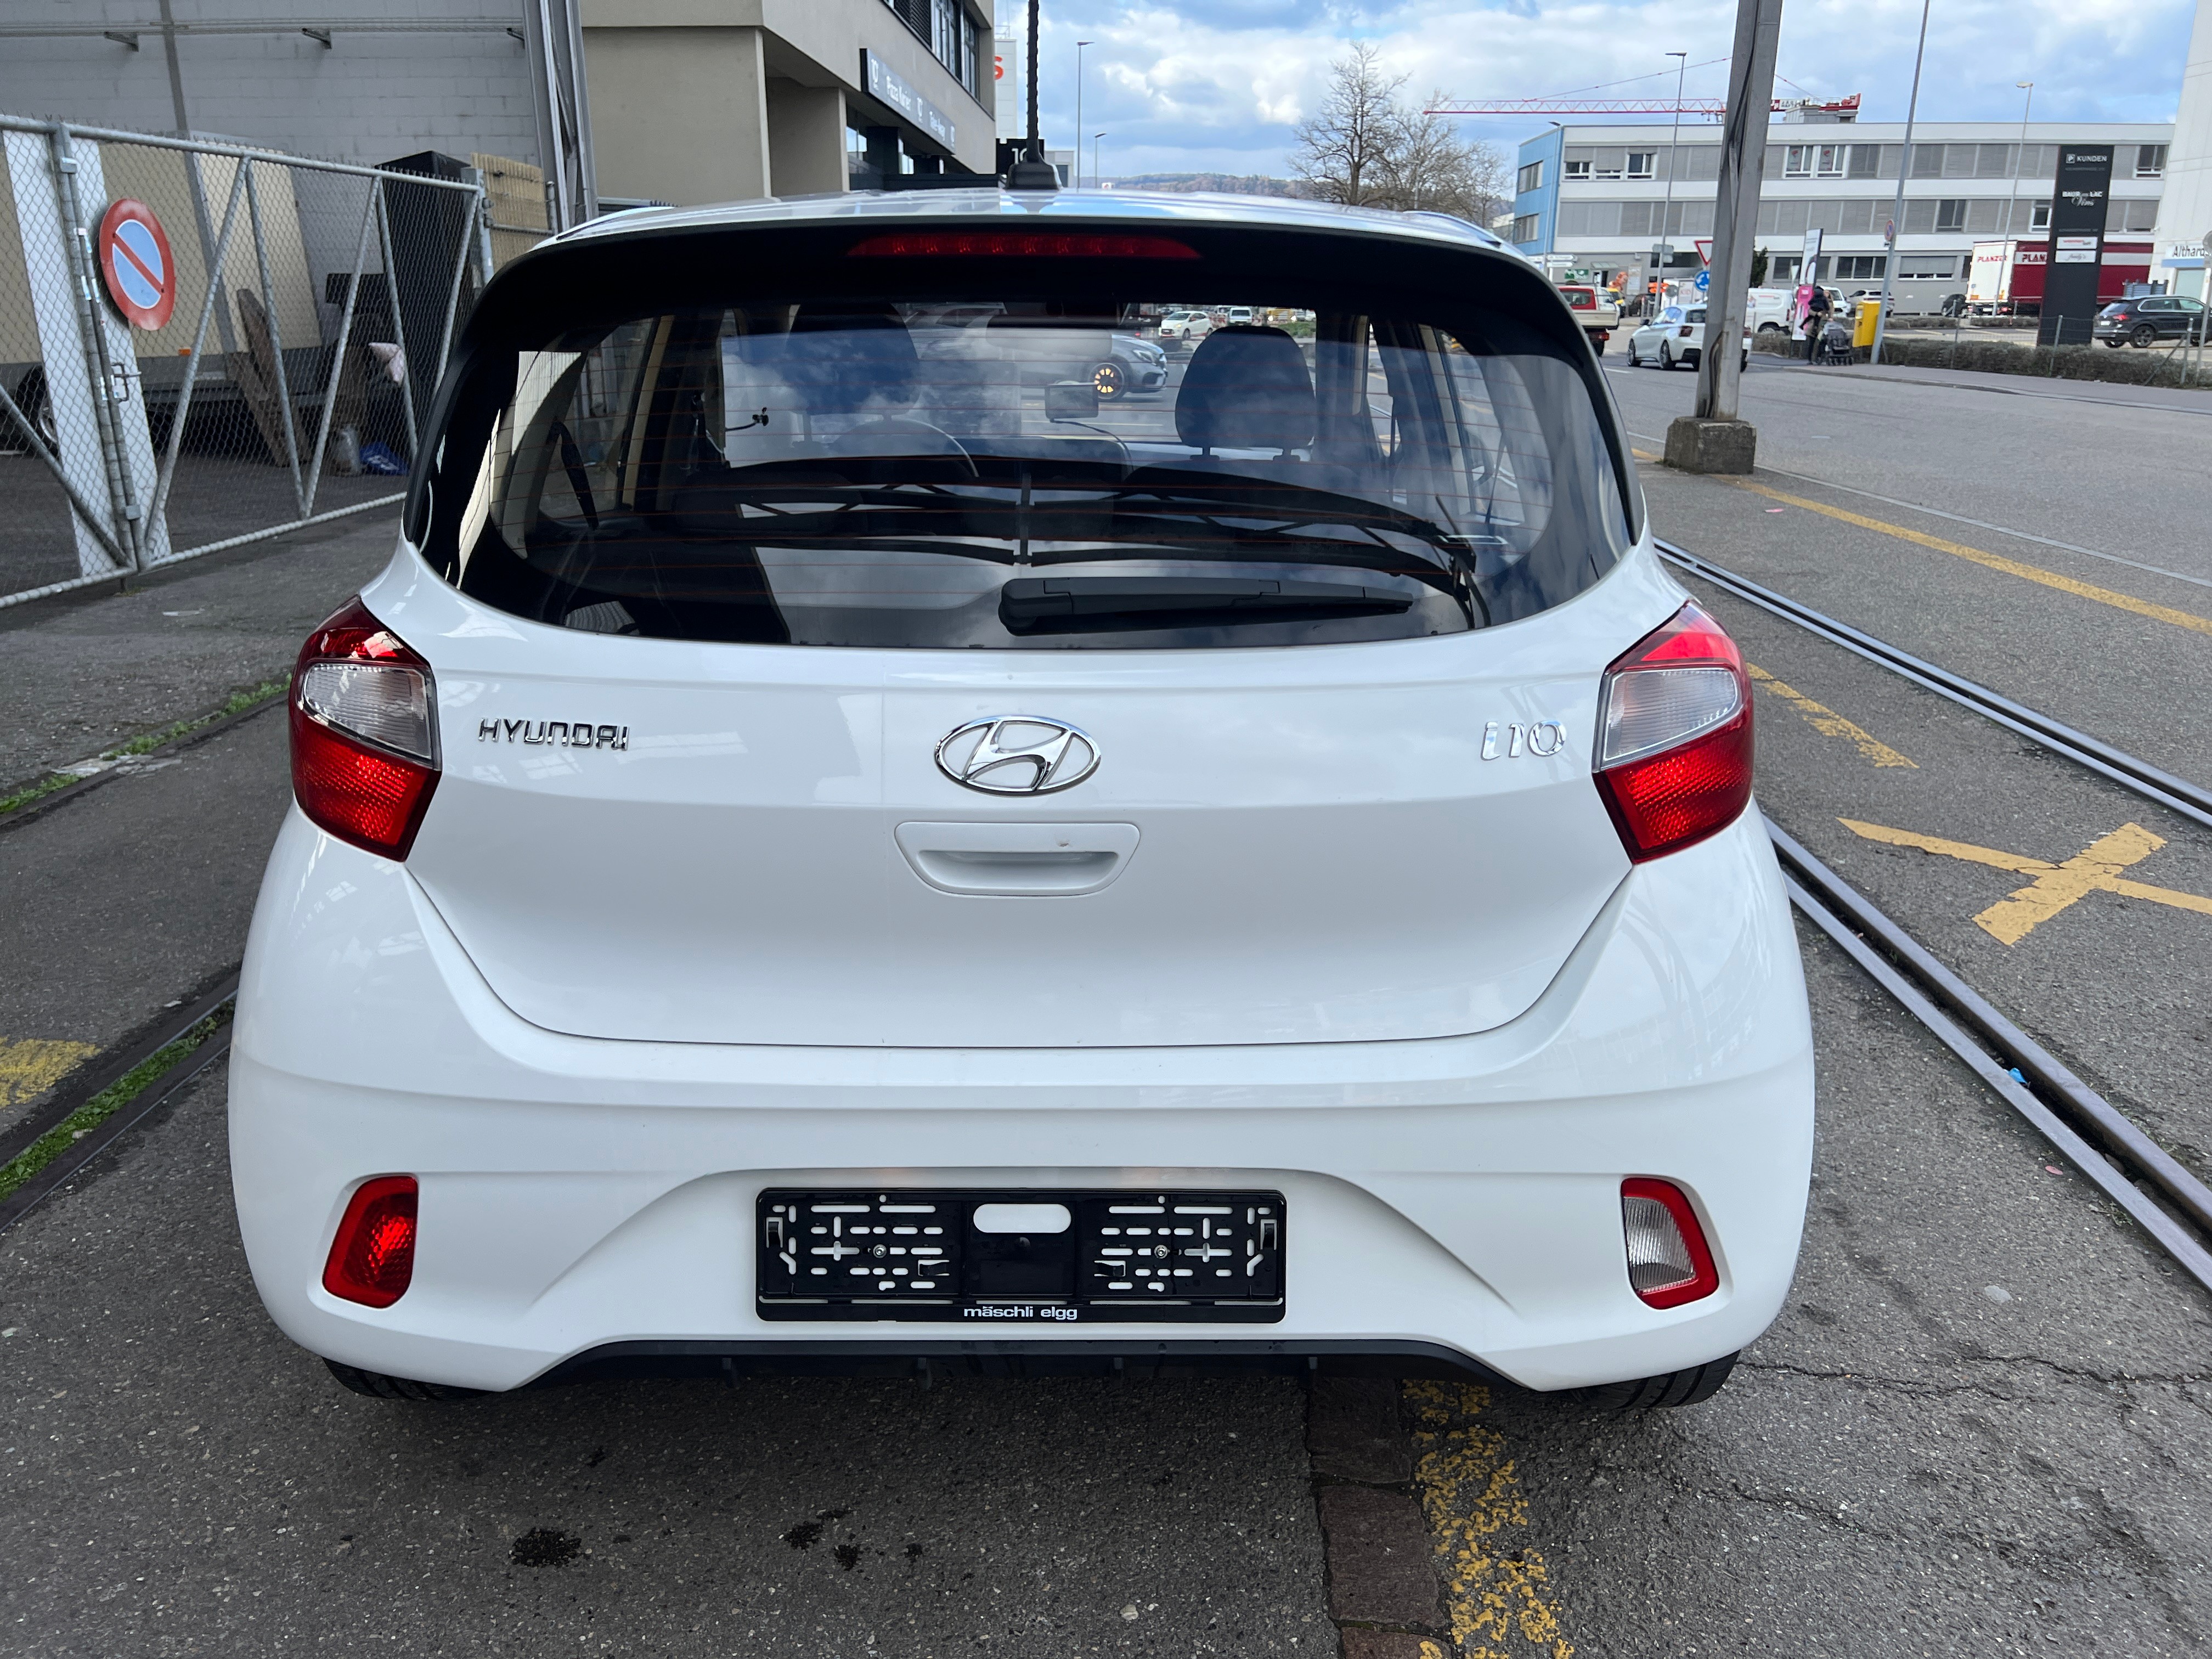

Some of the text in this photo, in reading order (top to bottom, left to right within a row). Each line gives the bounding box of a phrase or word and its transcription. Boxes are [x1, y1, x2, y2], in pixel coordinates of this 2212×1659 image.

[478, 718, 630, 751] HYUNDAI
[1481, 720, 1567, 761] i10
[964, 1306, 1077, 1321] mäschli elgg
